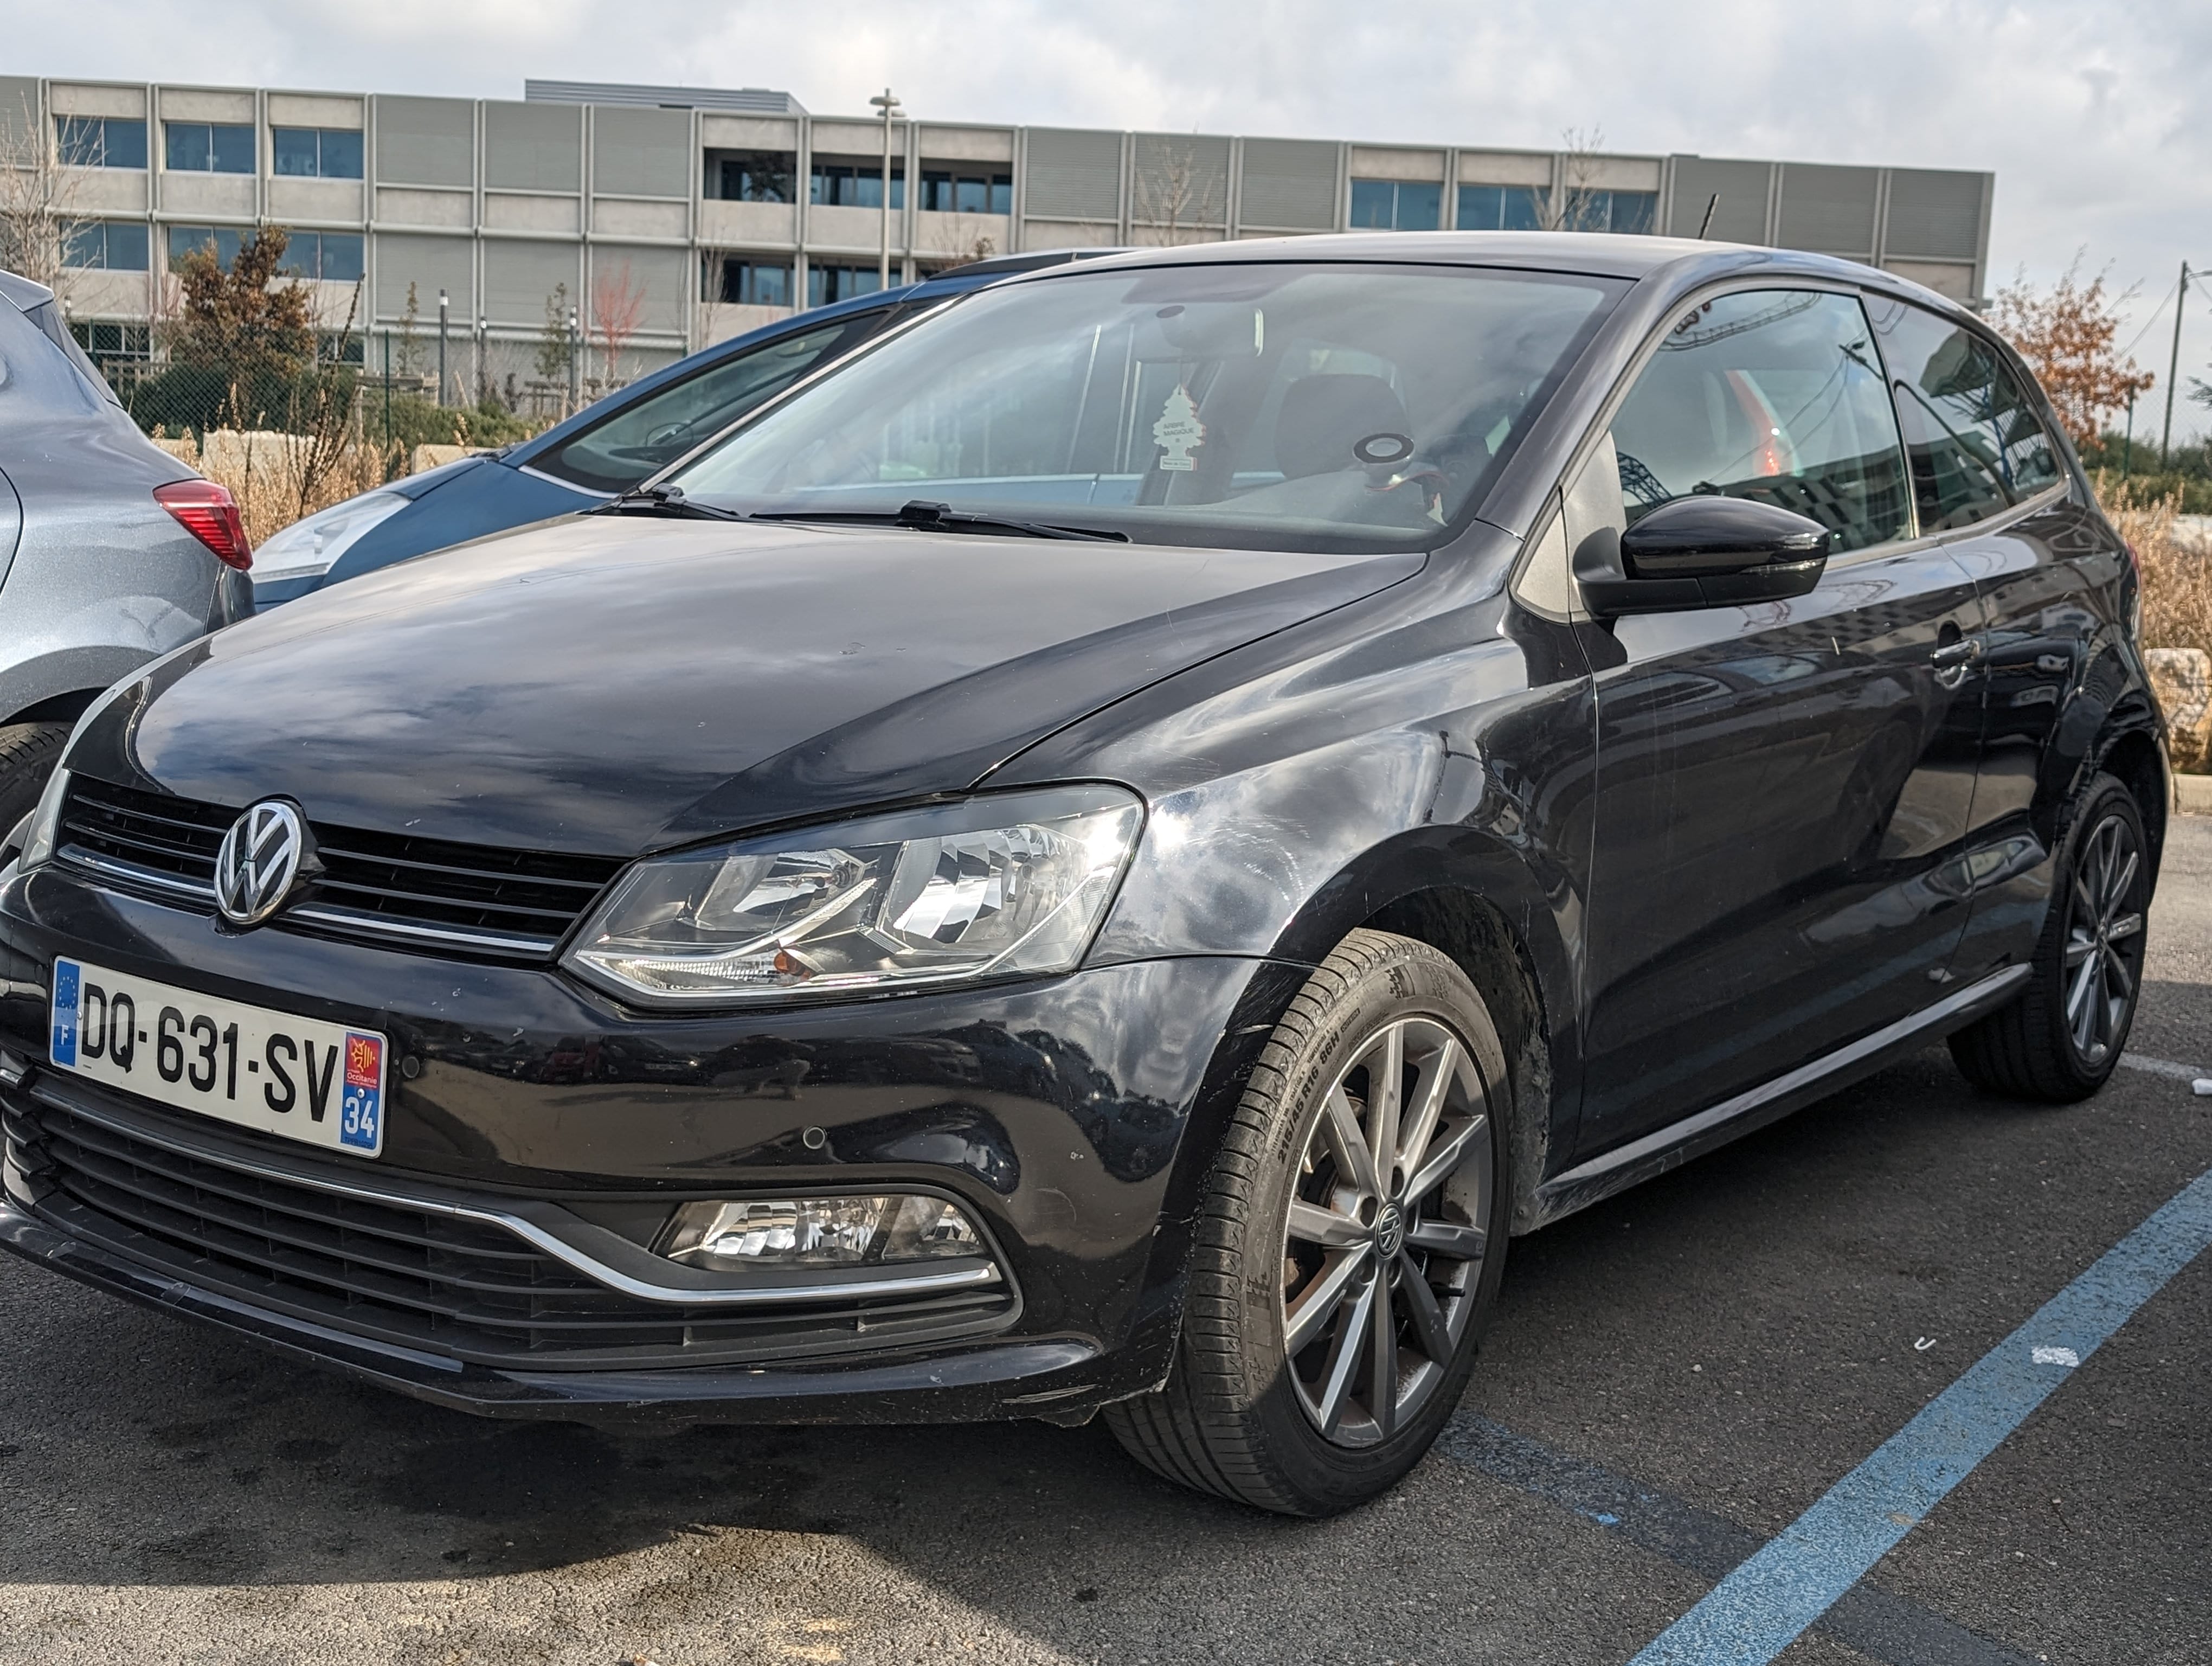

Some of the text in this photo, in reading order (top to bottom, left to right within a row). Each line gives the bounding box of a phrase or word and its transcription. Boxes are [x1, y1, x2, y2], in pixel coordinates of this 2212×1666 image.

[1163, 421, 1185, 430] ARBRE
[1163, 427, 1194, 436] MAGIQUE
[61, 1024, 69, 1046] F
[81, 982, 338, 1123] DQ-631-SV
[347, 1072, 377, 1085] Occitanie
[1278, 1098, 1304, 1164] 215/45
[1302, 1066, 1319, 1099] R16
[1320, 1031, 1340, 1064] 86H
[344, 1096, 375, 1138] 34
